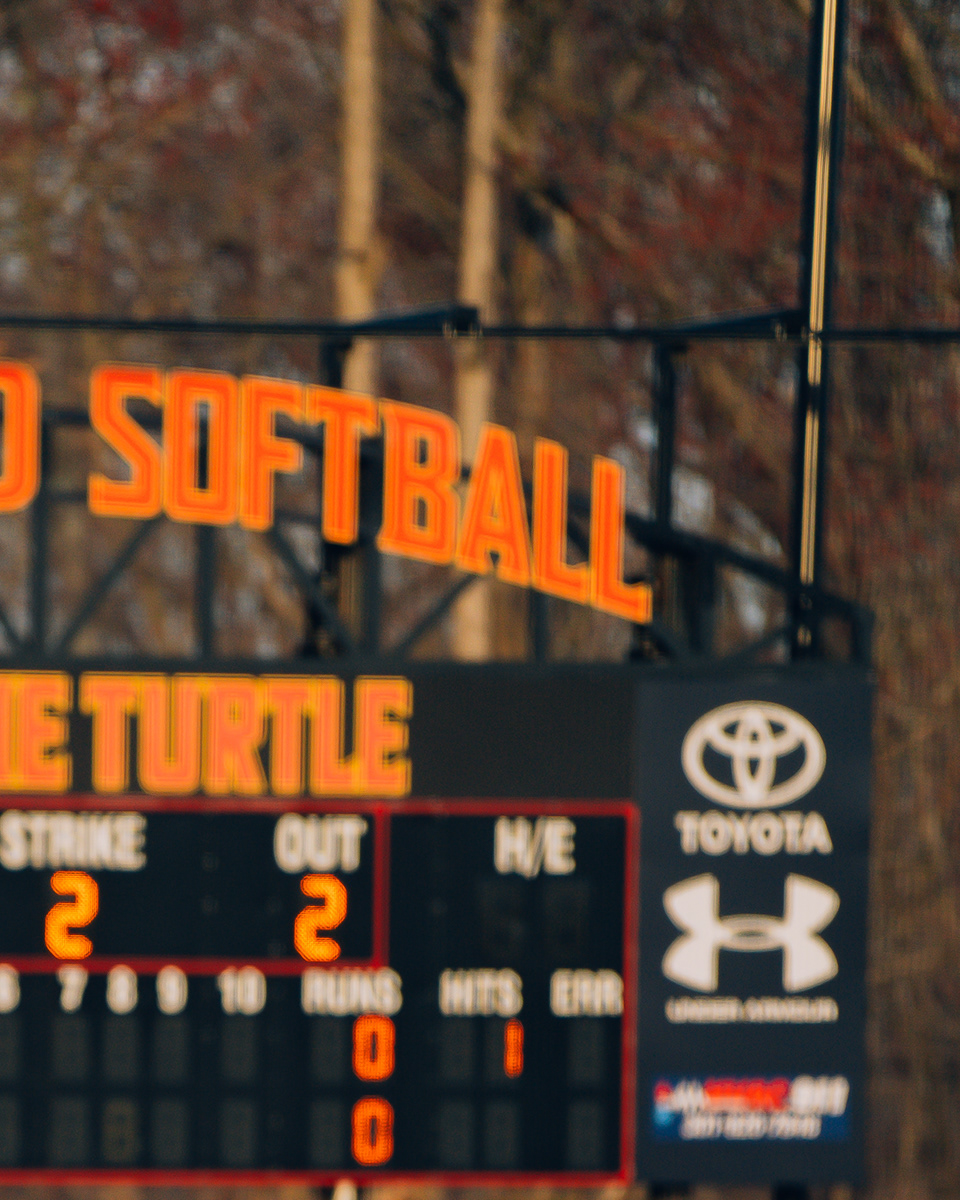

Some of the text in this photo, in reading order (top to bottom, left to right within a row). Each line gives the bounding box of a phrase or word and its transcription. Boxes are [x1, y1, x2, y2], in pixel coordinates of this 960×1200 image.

[87, 361, 653, 624] SOFTBALL
[79, 671, 414, 797] TURTLE
[273, 812, 368, 874] OUT
[494, 815, 576, 879] H/E
[673, 809, 834, 855] TOYOTA
[45, 870, 99, 960] 2
[294, 873, 348, 962] 2
[57, 963, 88, 1013] 7
[106, 964, 138, 1015] 8
[156, 964, 188, 1016] 9
[217, 965, 267, 1016] 10
[301, 966, 403, 1017] RUNS
[439, 968, 523, 1018] HITS
[550, 968, 624, 1018] ERR
[352, 1014, 396, 1082] 0
[504, 1017, 524, 1078] 1
[351, 1096, 395, 1167] 0
